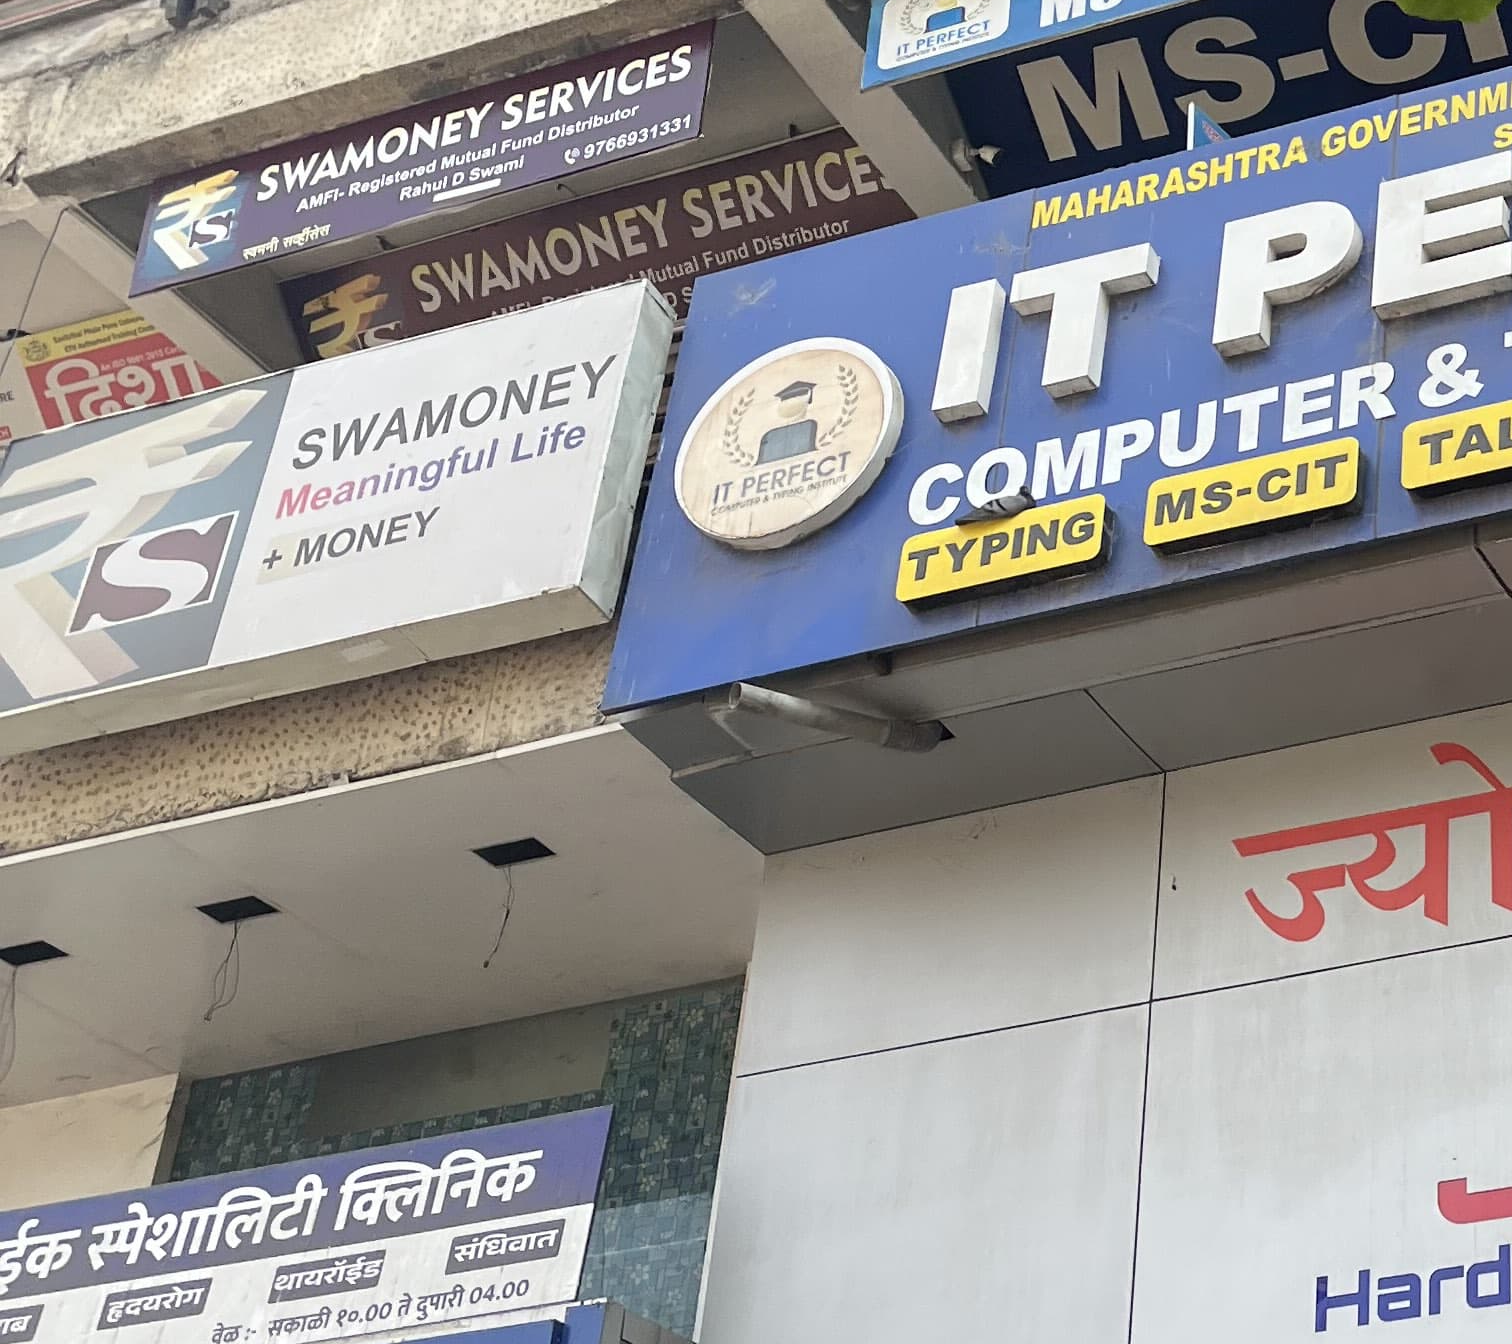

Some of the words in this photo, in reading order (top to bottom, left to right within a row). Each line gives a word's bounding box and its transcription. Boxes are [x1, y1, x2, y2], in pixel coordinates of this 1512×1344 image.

[915, 19, 991, 51] PERFECT
[256, 100, 494, 202] SWAMONEY
[499, 43, 694, 132] SERVICES
[347, 159, 439, 200] Registered
[439, 141, 498, 174] Mutual
[499, 129, 545, 164] Fund
[546, 102, 641, 140] Distributor
[582, 114, 694, 161] 9766931331
[399, 175, 448, 203] Rahul
[450, 168, 468, 189] D
[468, 154, 525, 184] Swami
[1031, 135, 1309, 230] MAHARASHTRA
[411, 198, 670, 316] SWAMONEY
[703, 241, 750, 275] Fund
[752, 217, 851, 258] Distributor
[932, 240, 1161, 424] IT
[291, 354, 618, 472] SWAMONEY
[908, 359, 1398, 527] COMPUTER
[1417, 342, 1486, 408] &
[275, 441, 498, 520] Meaningful
[509, 419, 588, 466] Life
[712, 481, 734, 505] IT
[740, 450, 852, 499] PERFECT
[905, 510, 1097, 584] TYPING
[1153, 452, 1350, 527] MS-CIT
[291, 505, 441, 571] MONEY
[88, 1170, 335, 1274] स्पेशालिटी
[331, 1145, 545, 1233] क्लिनिक
[452, 1226, 559, 1265] संधिवात
